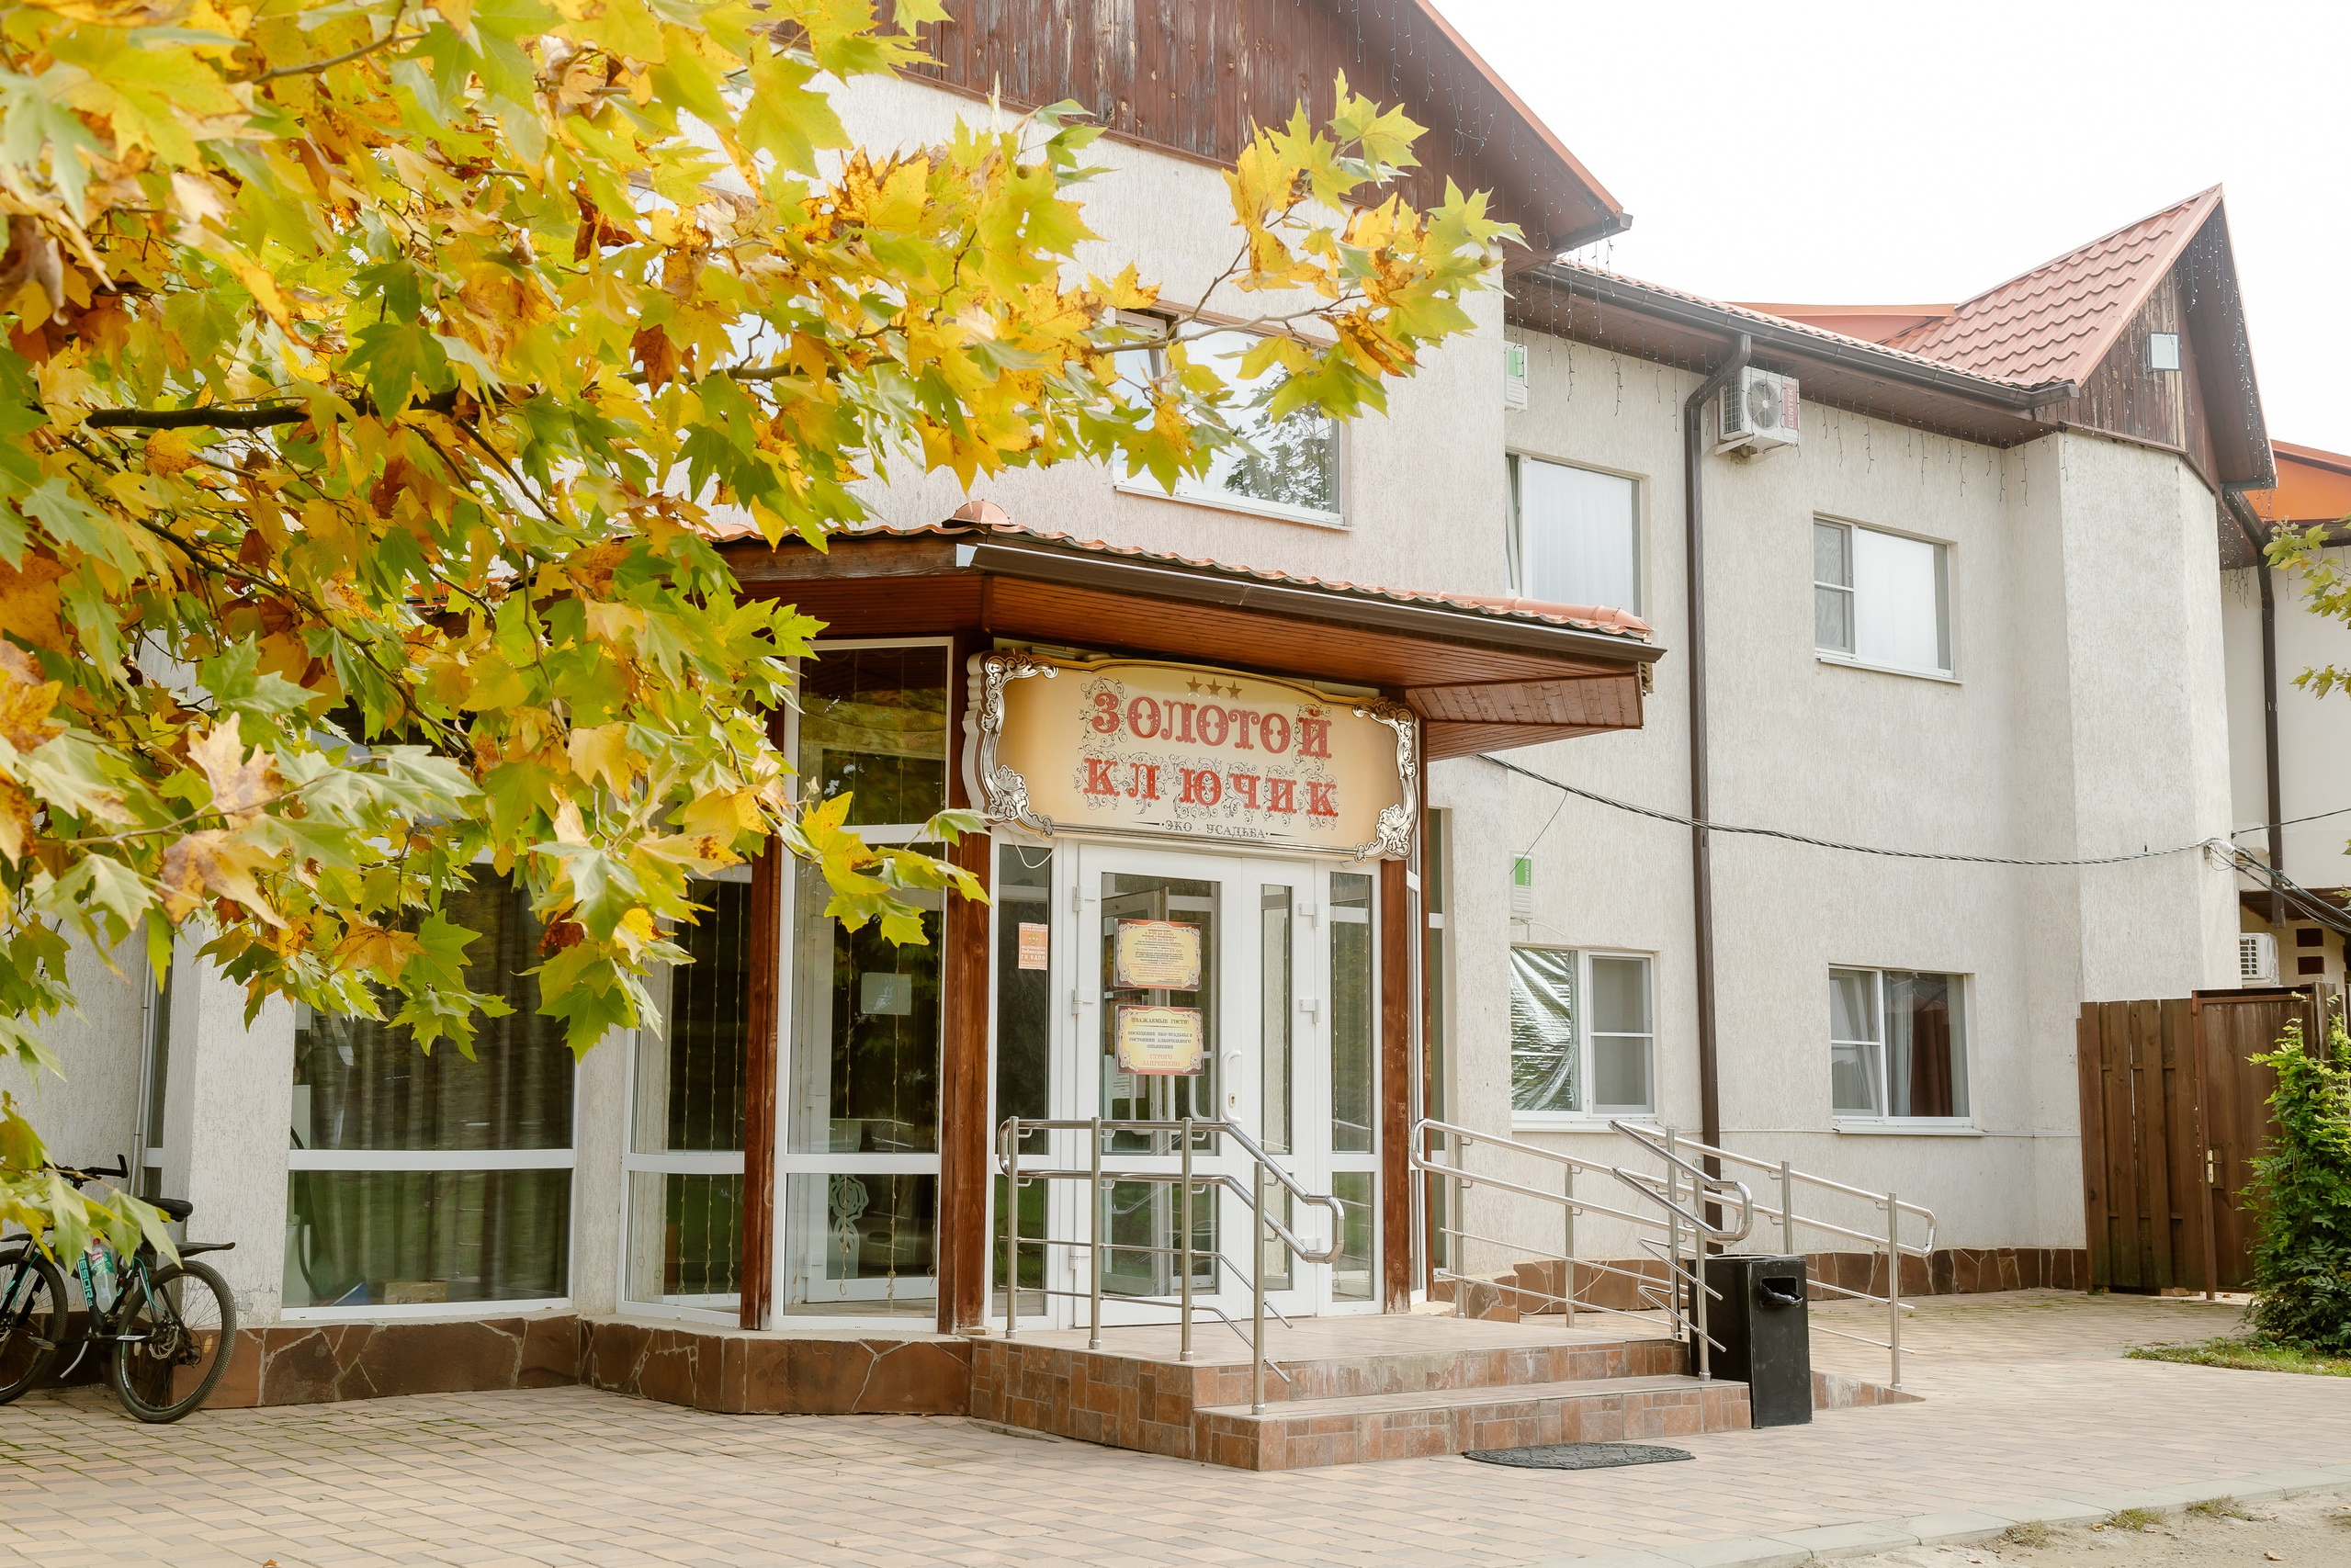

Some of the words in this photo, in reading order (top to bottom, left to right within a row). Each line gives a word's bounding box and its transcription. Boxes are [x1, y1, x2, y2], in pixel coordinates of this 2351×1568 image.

[1091, 692, 1333, 760] ЗОЛОТОЙ
[1082, 757, 1339, 818] КЛЮЧИК
[1165, 819, 1192, 832] ЭКО
[1205, 823, 1266, 839] УСАДЬБА
